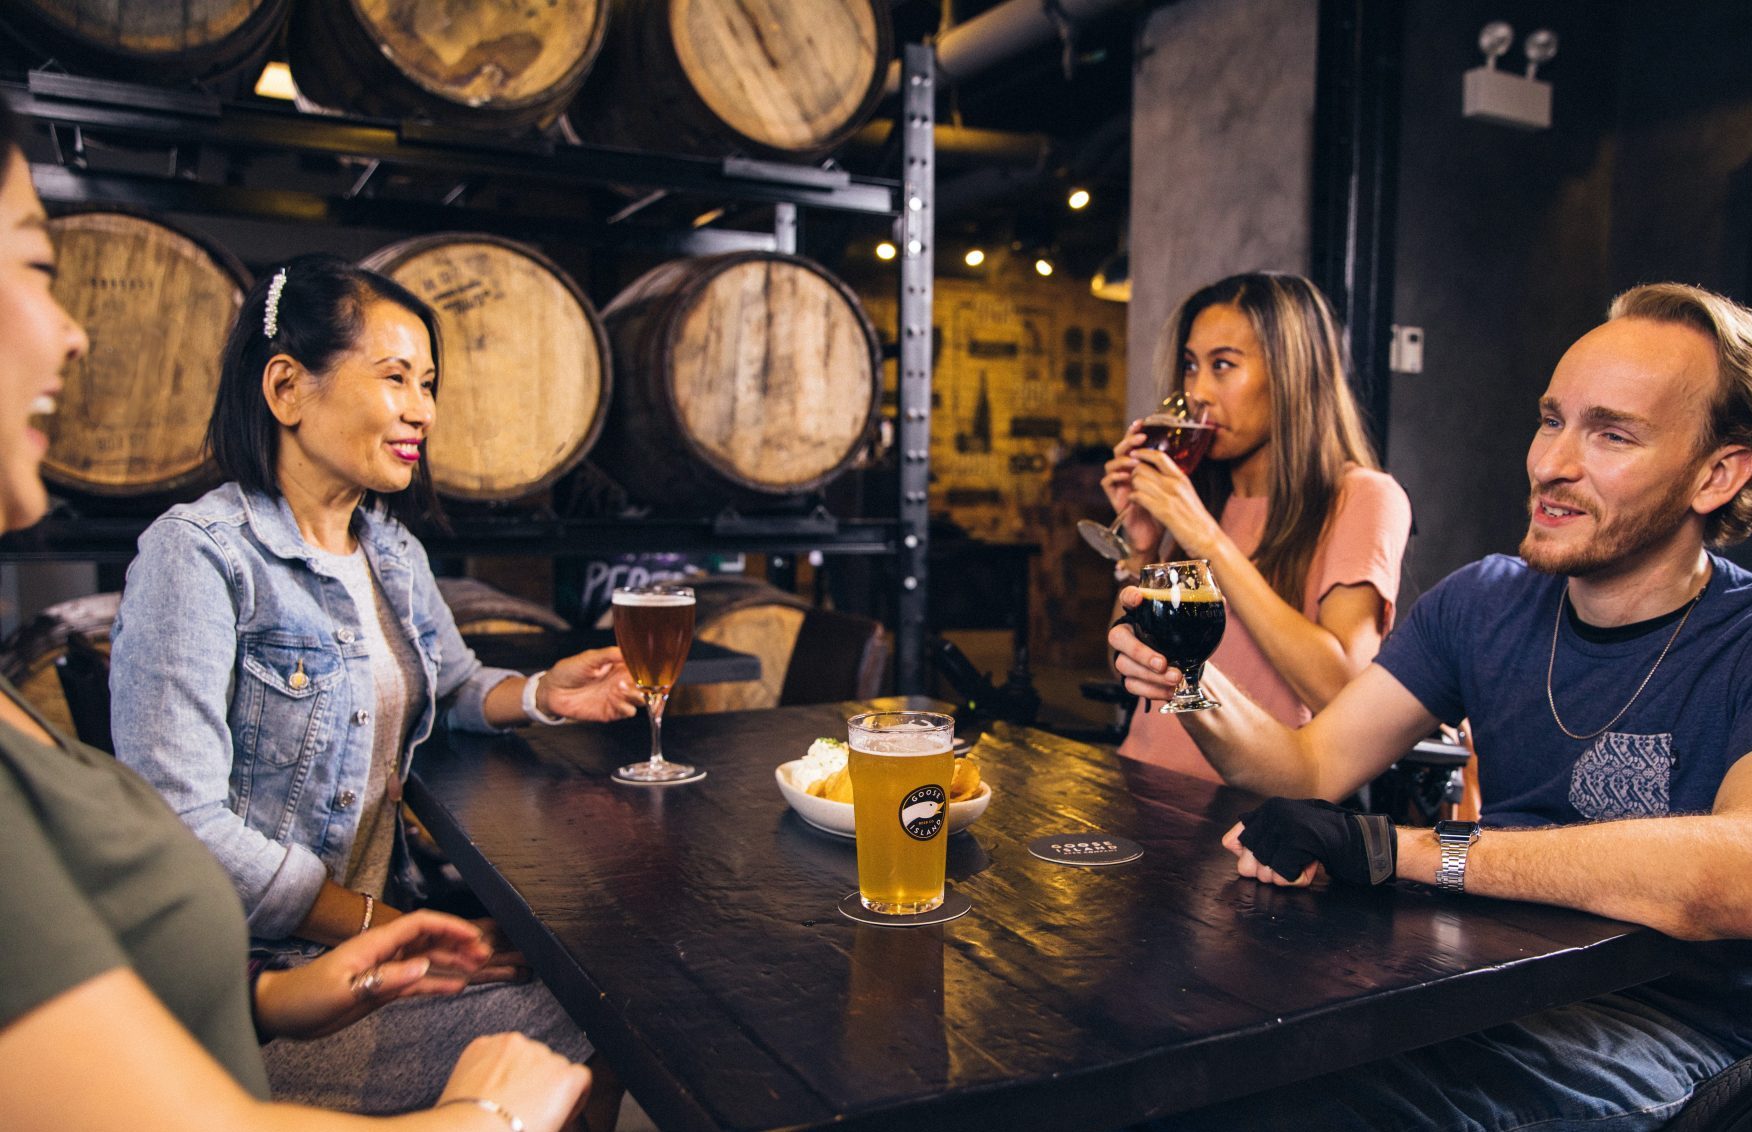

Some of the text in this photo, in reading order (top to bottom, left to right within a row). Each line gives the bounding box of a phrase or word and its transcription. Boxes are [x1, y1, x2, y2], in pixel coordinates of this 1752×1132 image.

[911, 789, 941, 802] GOOSE
[909, 819, 941, 836] ISLAND
[1051, 841, 1112, 849] GOOSE
[1055, 845, 1118, 853] ISLAND
